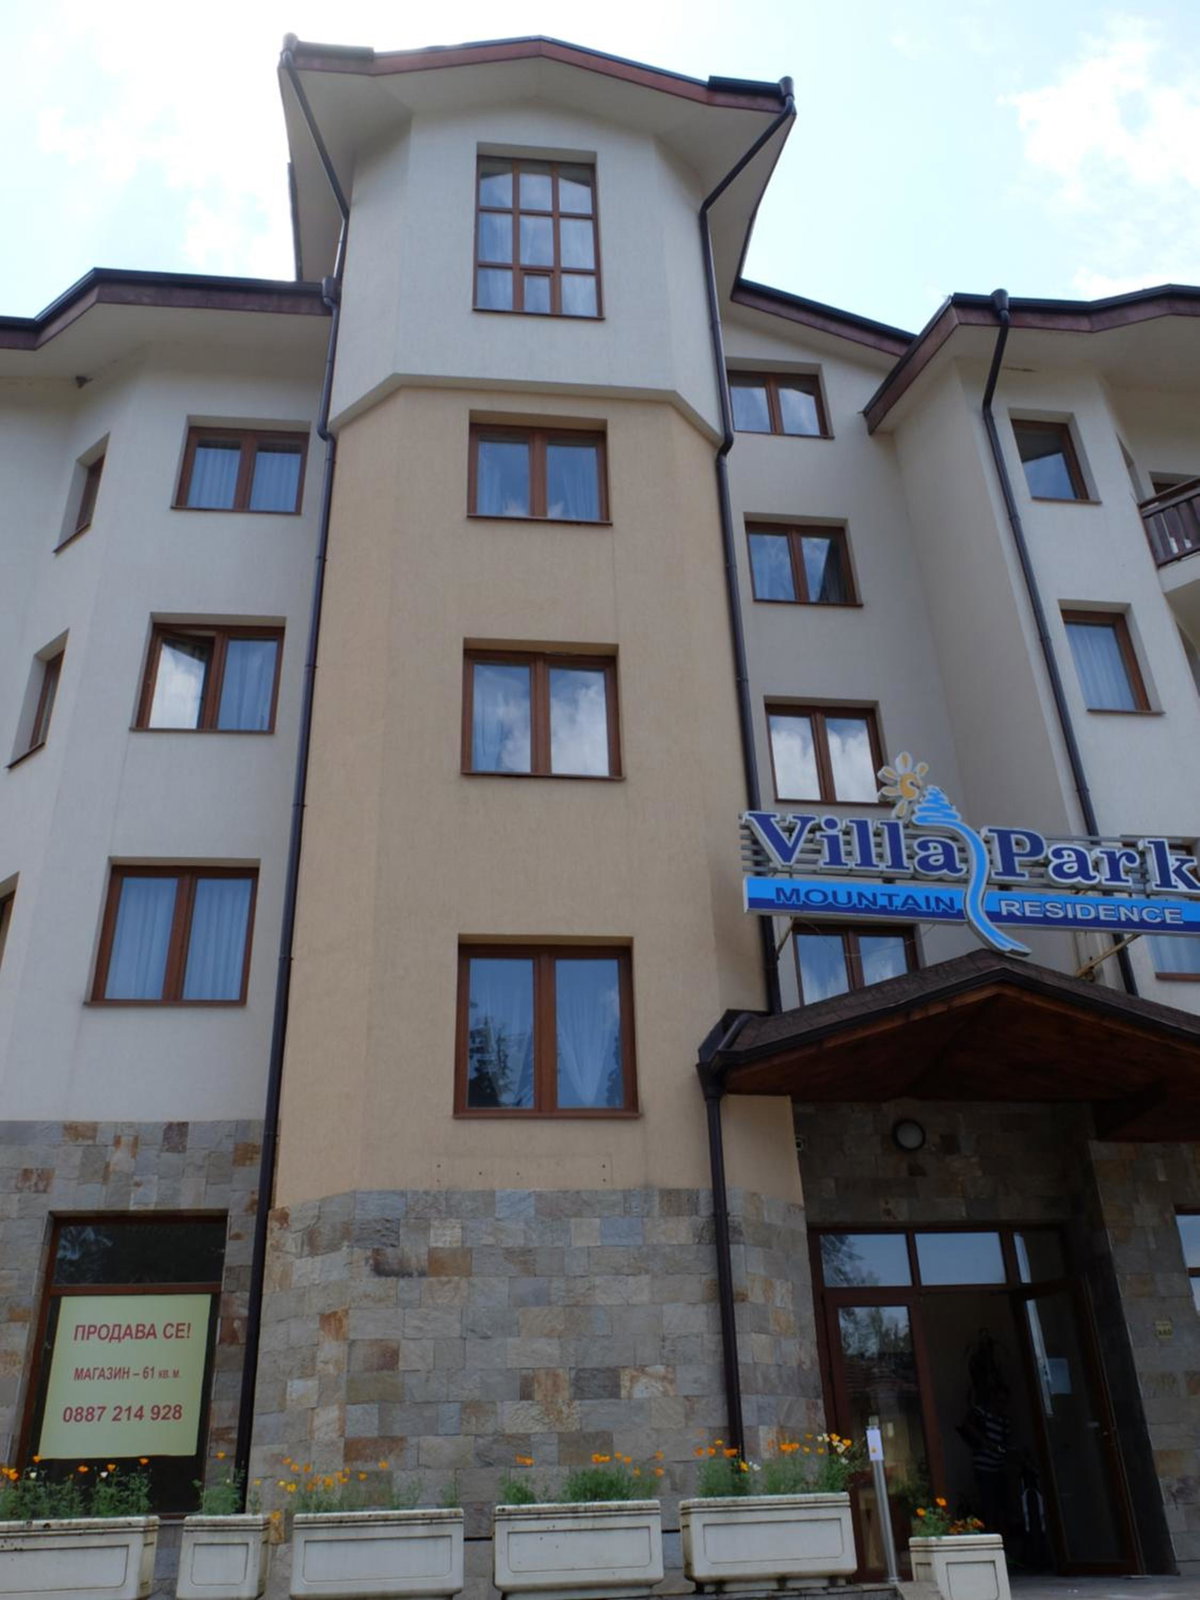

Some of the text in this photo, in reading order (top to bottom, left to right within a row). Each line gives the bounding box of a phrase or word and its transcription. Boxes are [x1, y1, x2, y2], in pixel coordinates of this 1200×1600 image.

[744, 810, 1200, 891] Villa Park
[774, 885, 1184, 924] MOUNTAIN RESIDENCE
[73, 1323, 191, 1343] ПРОДАВА СЕ!
[73, 1366, 130, 1381] МАГАЗИН
[142, 1366, 155, 1380] 61
[62, 1404, 183, 1423] 0887 214 928
